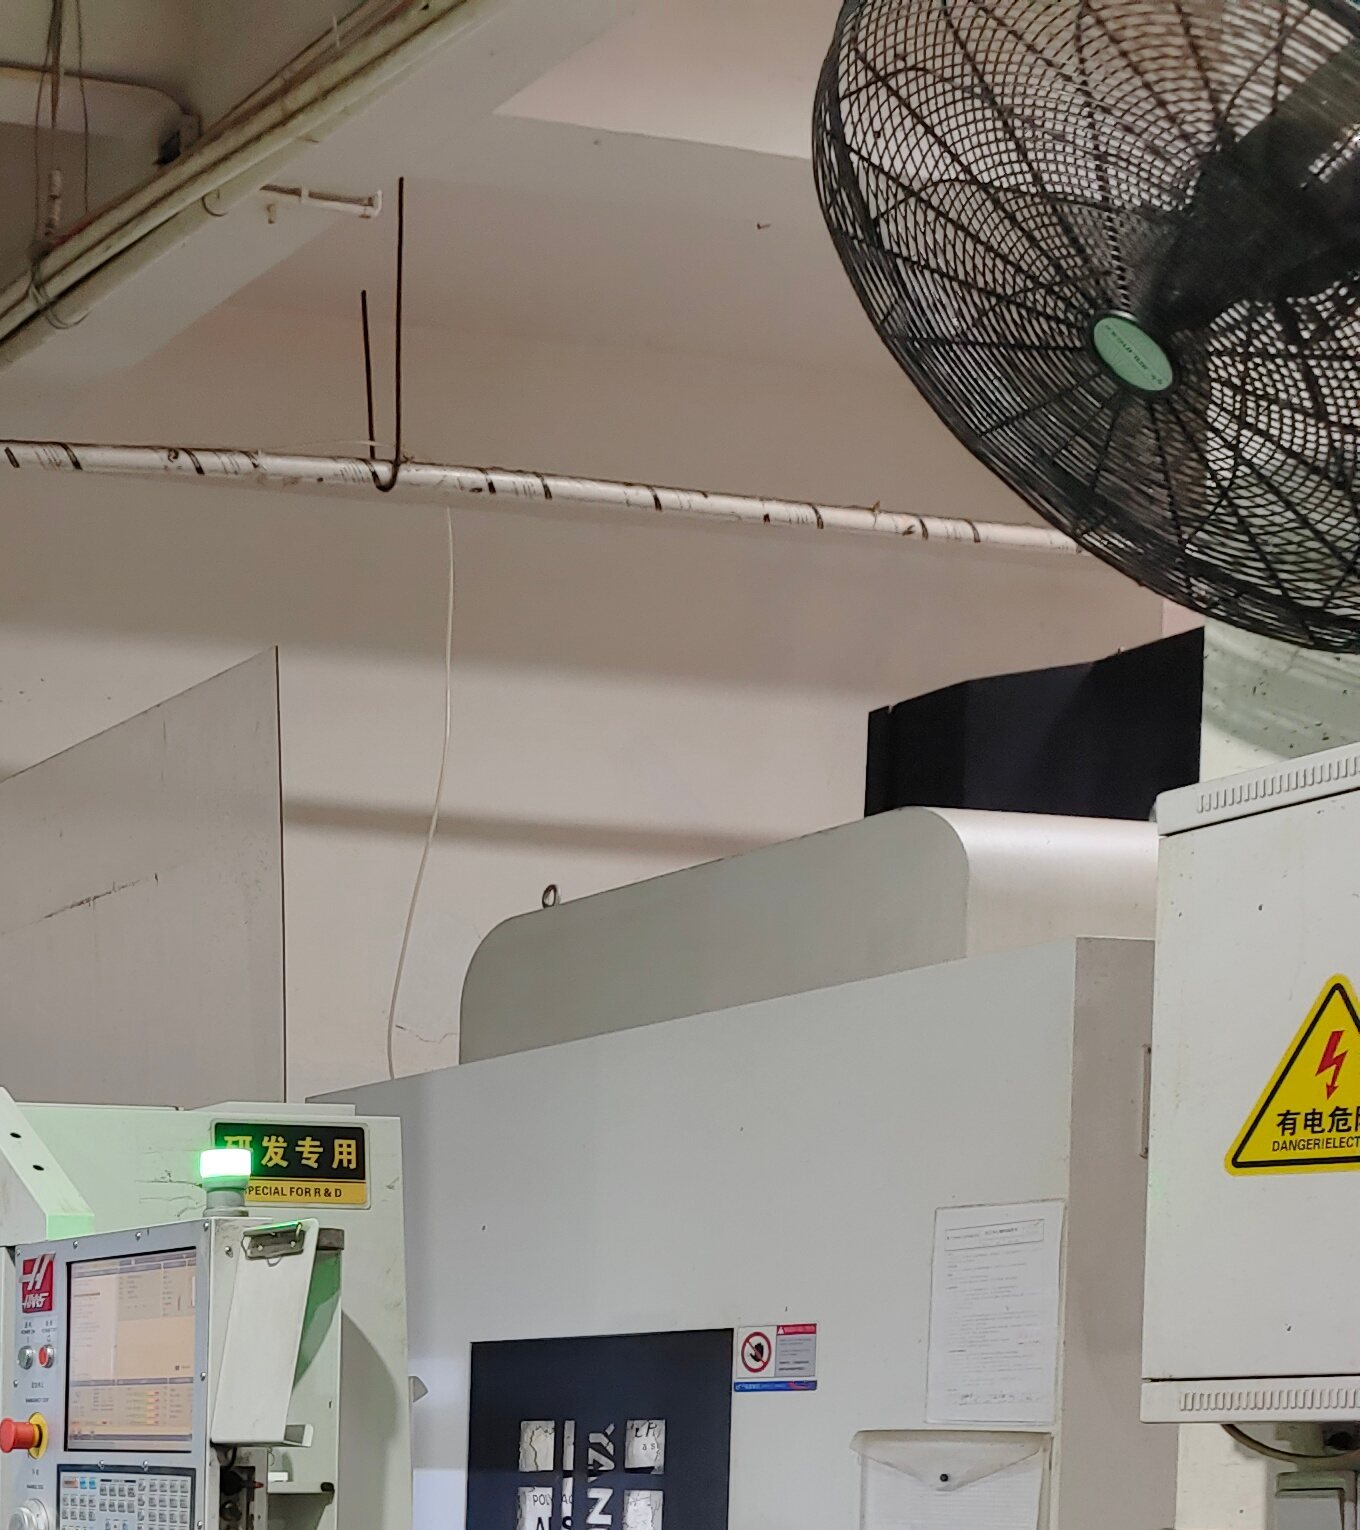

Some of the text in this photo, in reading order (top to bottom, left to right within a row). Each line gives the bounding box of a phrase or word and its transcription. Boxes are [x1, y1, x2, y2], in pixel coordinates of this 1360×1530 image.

[1276, 1105, 1360, 1137] 有电危
[246, 1185, 287, 1197] PECIAL
[289, 1186, 314, 1197] FOR
[334, 1188, 342, 1198] D
